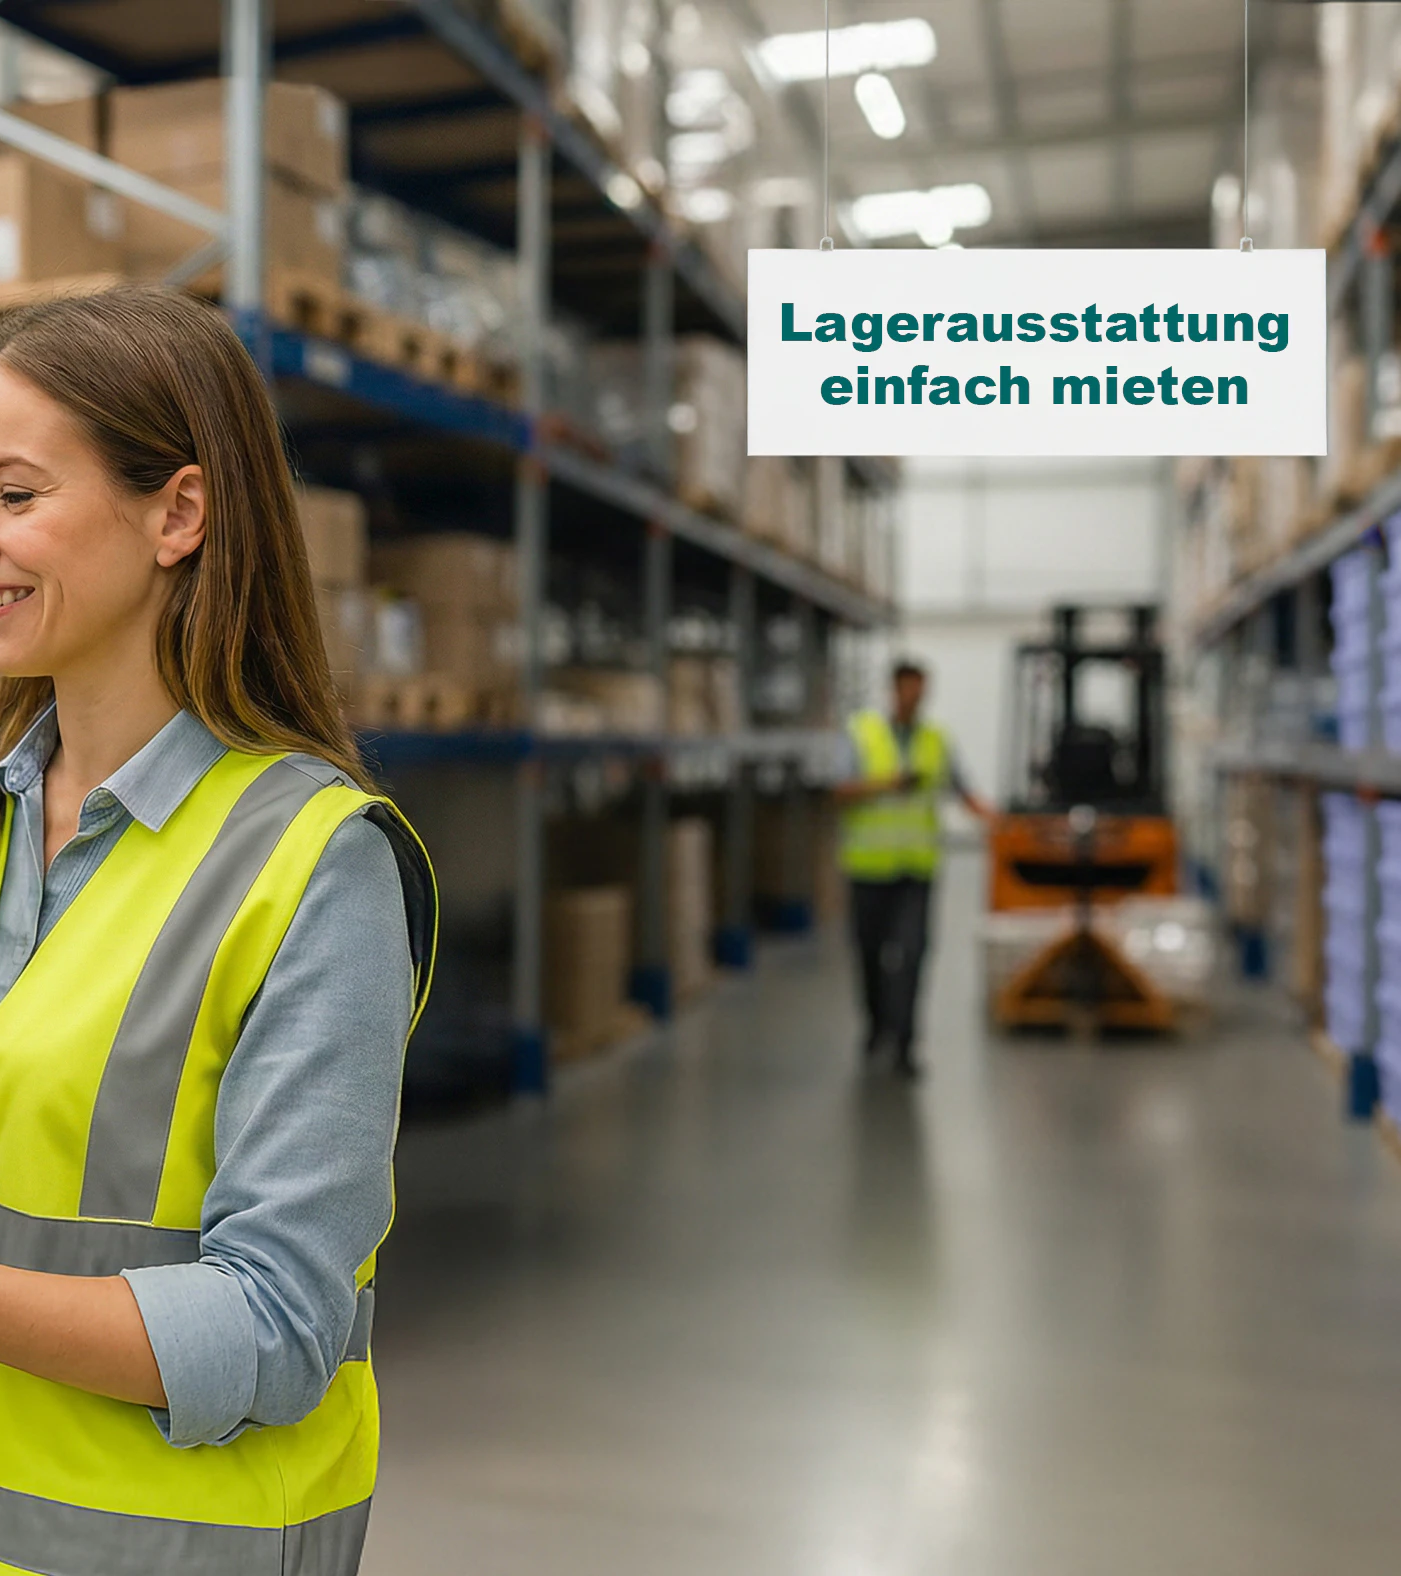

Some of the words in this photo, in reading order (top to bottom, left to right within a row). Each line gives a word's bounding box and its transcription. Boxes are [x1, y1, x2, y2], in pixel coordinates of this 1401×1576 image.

[781, 302, 1290, 352] Lagerausstattung
[820, 364, 1030, 405] einfach
[1052, 364, 1248, 405] mieten
